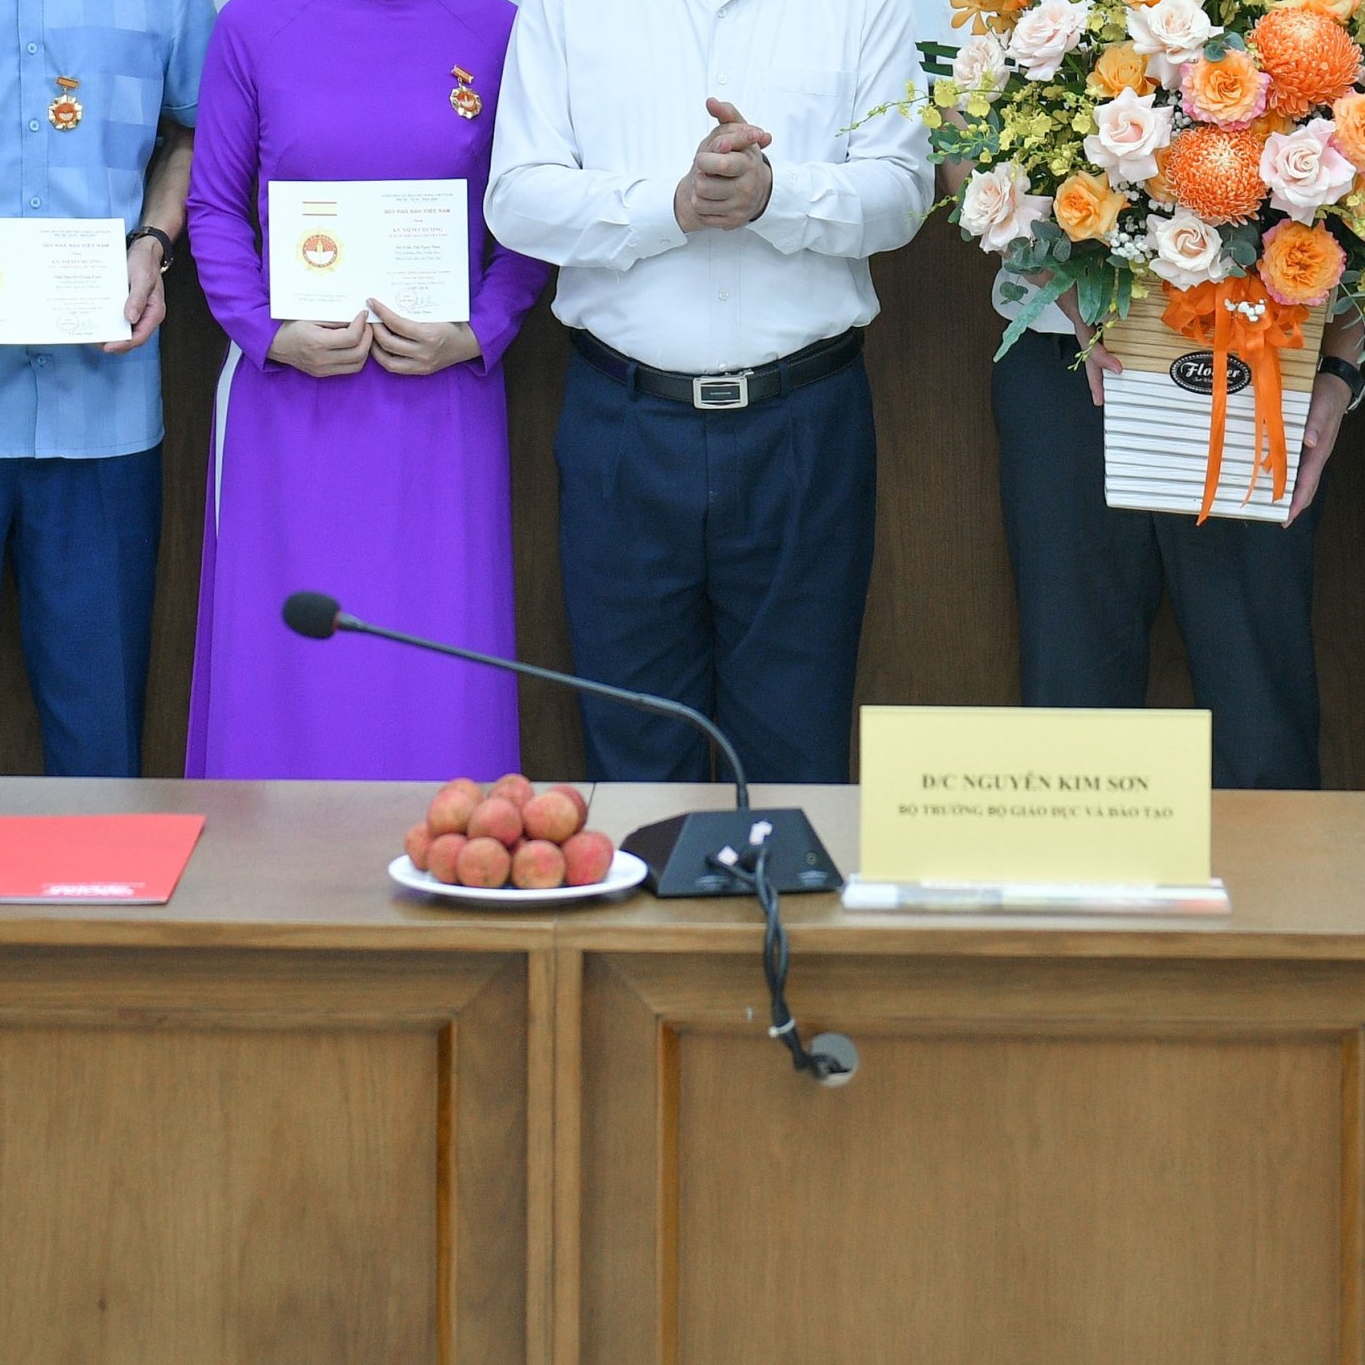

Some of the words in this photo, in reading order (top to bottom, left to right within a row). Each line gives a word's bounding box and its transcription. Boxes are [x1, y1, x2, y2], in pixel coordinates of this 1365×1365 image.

[1180, 361, 1241, 378] Floer
[921, 773, 960, 791] Đ/C
[1058, 774, 1102, 792] KIM
[1107, 774, 1150, 792] SƠN
